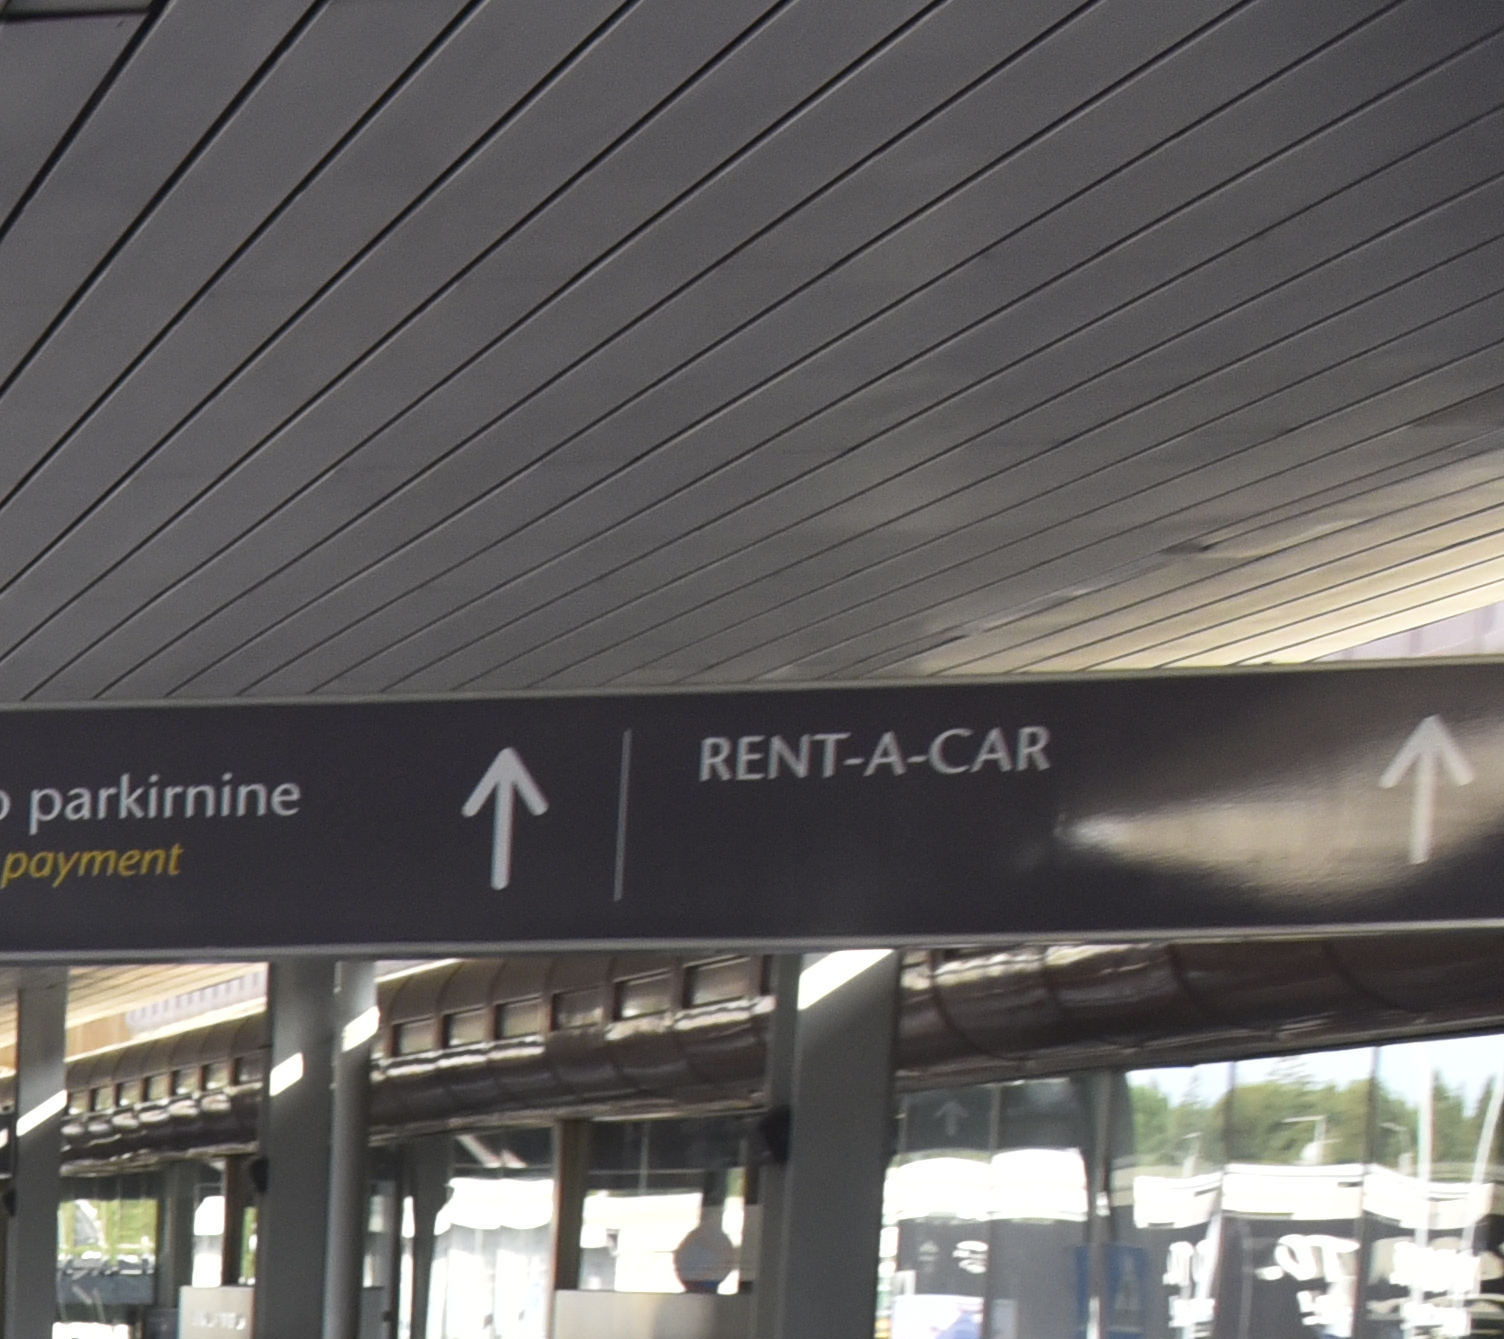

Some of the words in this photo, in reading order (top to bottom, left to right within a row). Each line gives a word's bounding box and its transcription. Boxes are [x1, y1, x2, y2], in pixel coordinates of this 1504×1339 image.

[698, 724, 1052, 786] RENT-A-CAR
[29, 773, 302, 836] parkirnine
[0, 842, 185, 889] payment
